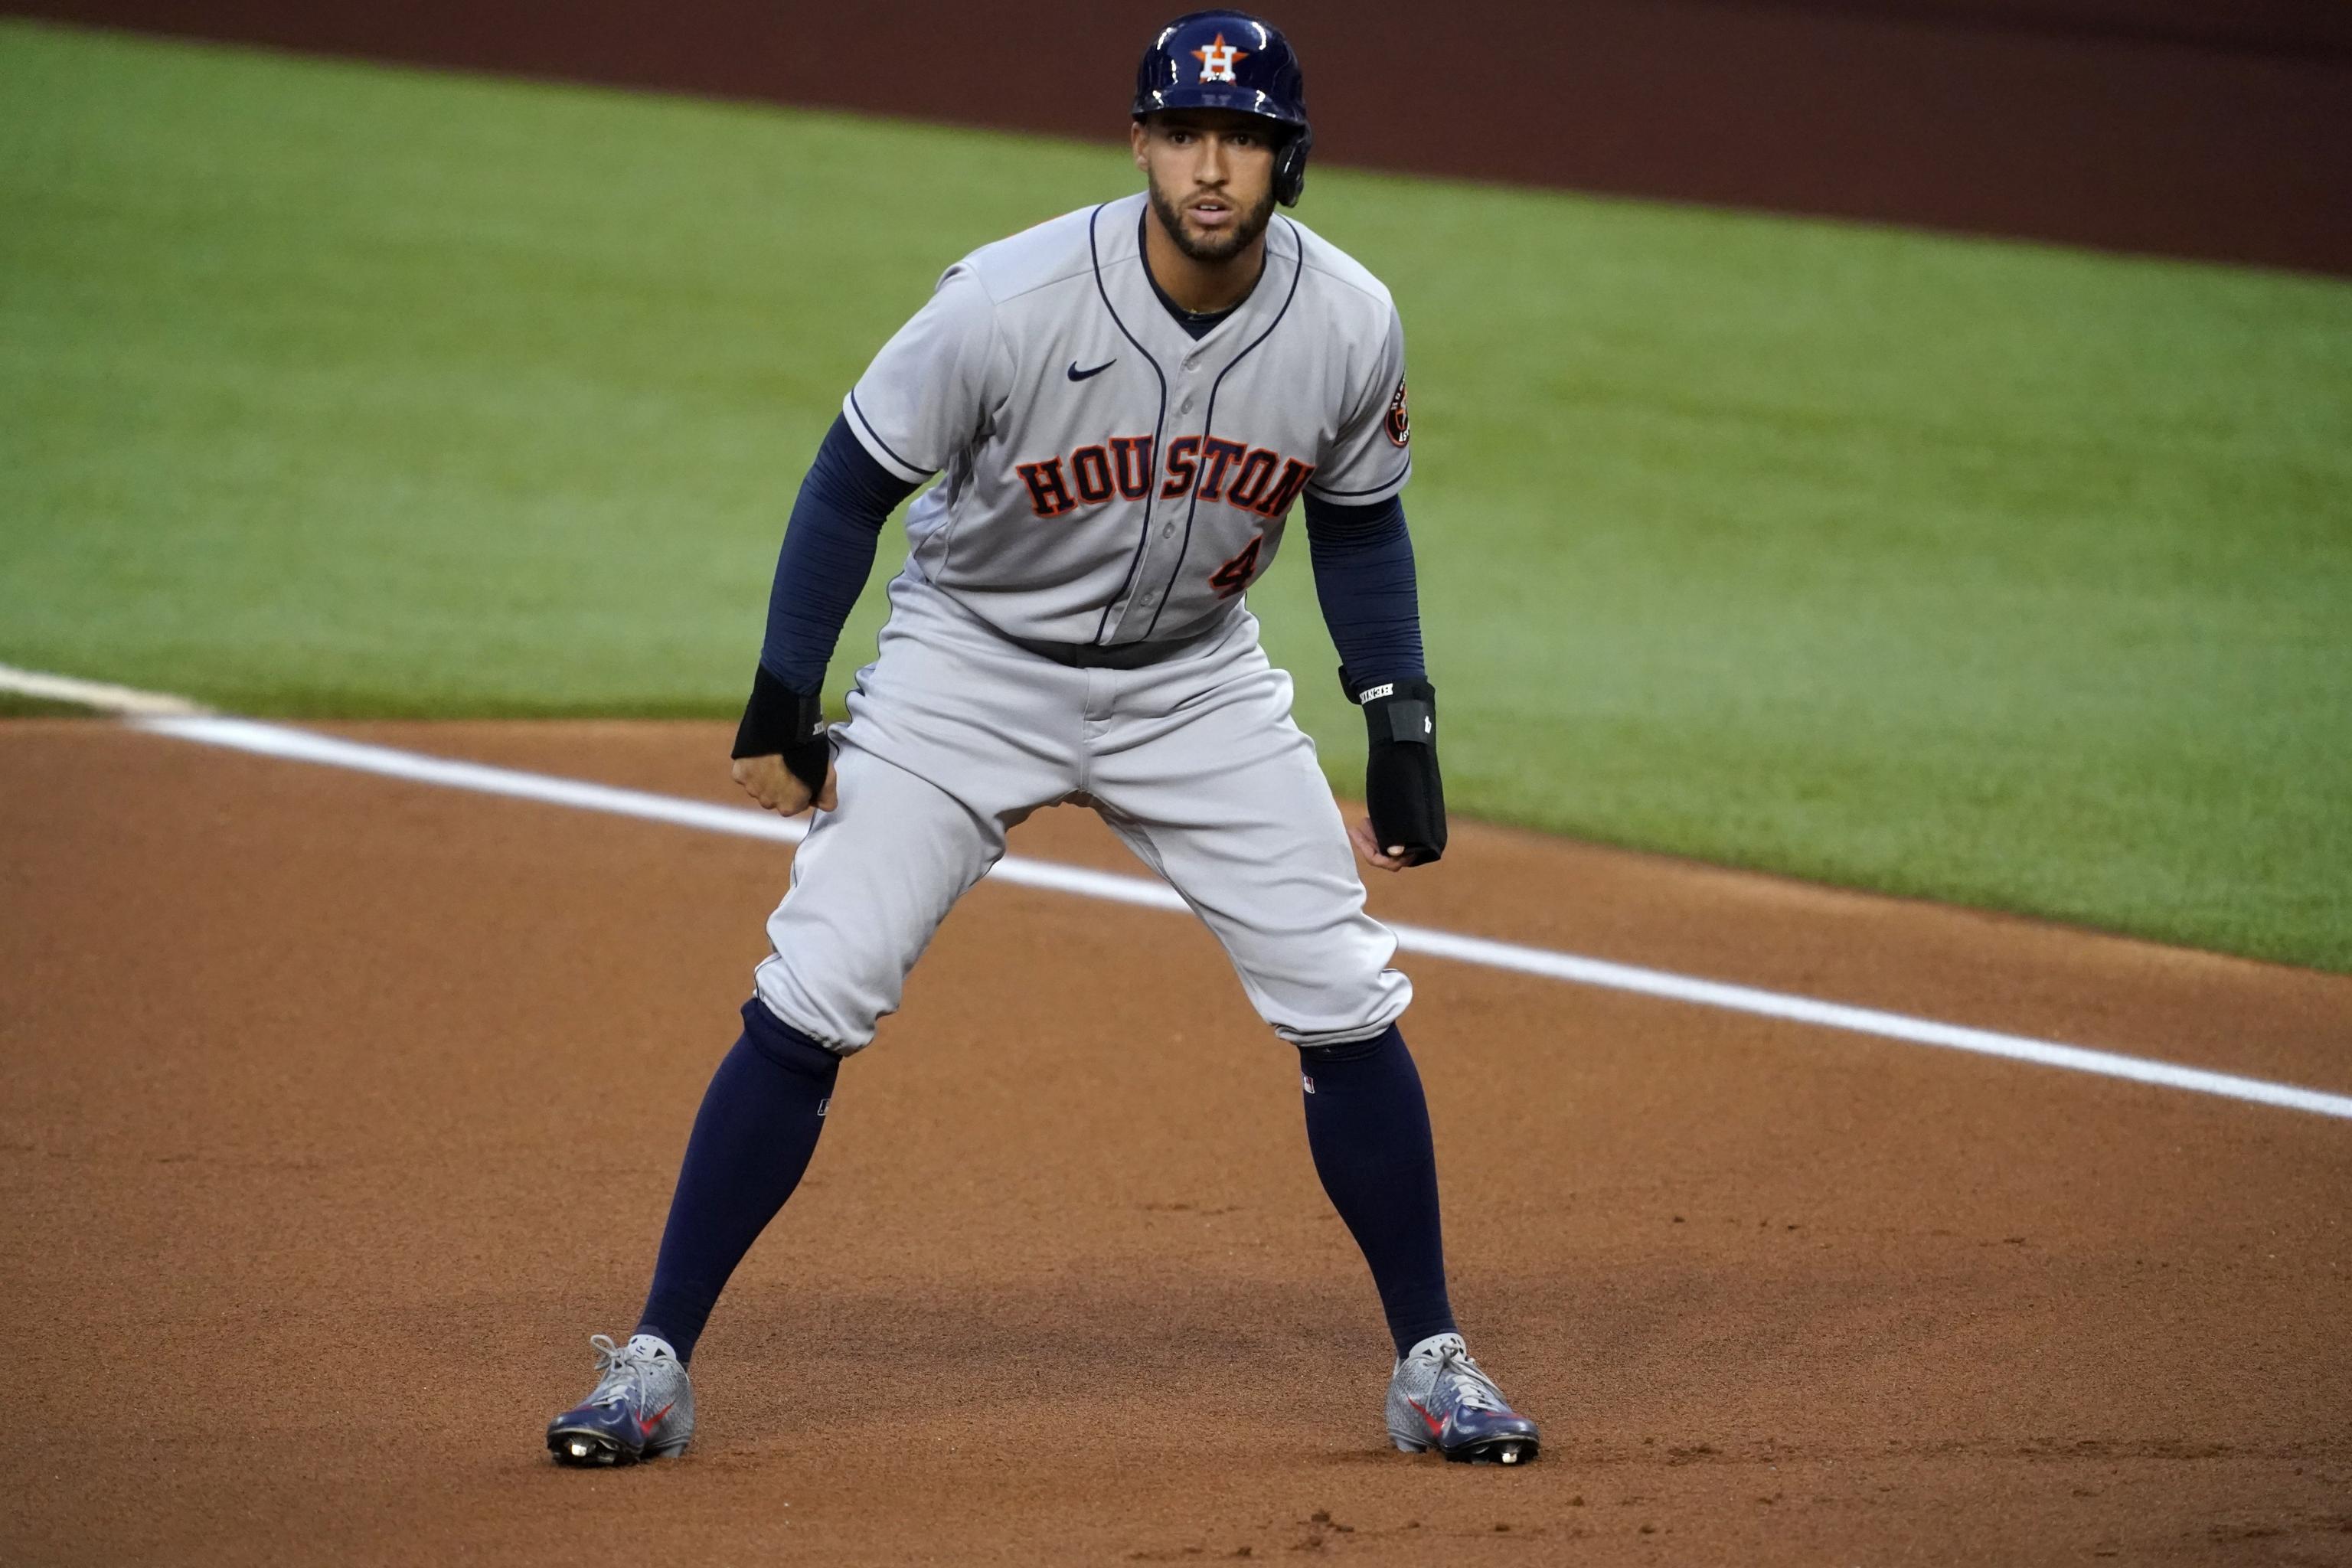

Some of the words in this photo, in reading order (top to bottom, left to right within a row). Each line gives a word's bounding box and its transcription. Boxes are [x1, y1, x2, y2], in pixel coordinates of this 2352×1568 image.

[1200, 45, 1237, 81] H
[1016, 435, 1316, 518] HOUSTON
[1209, 535, 1263, 599] 4
